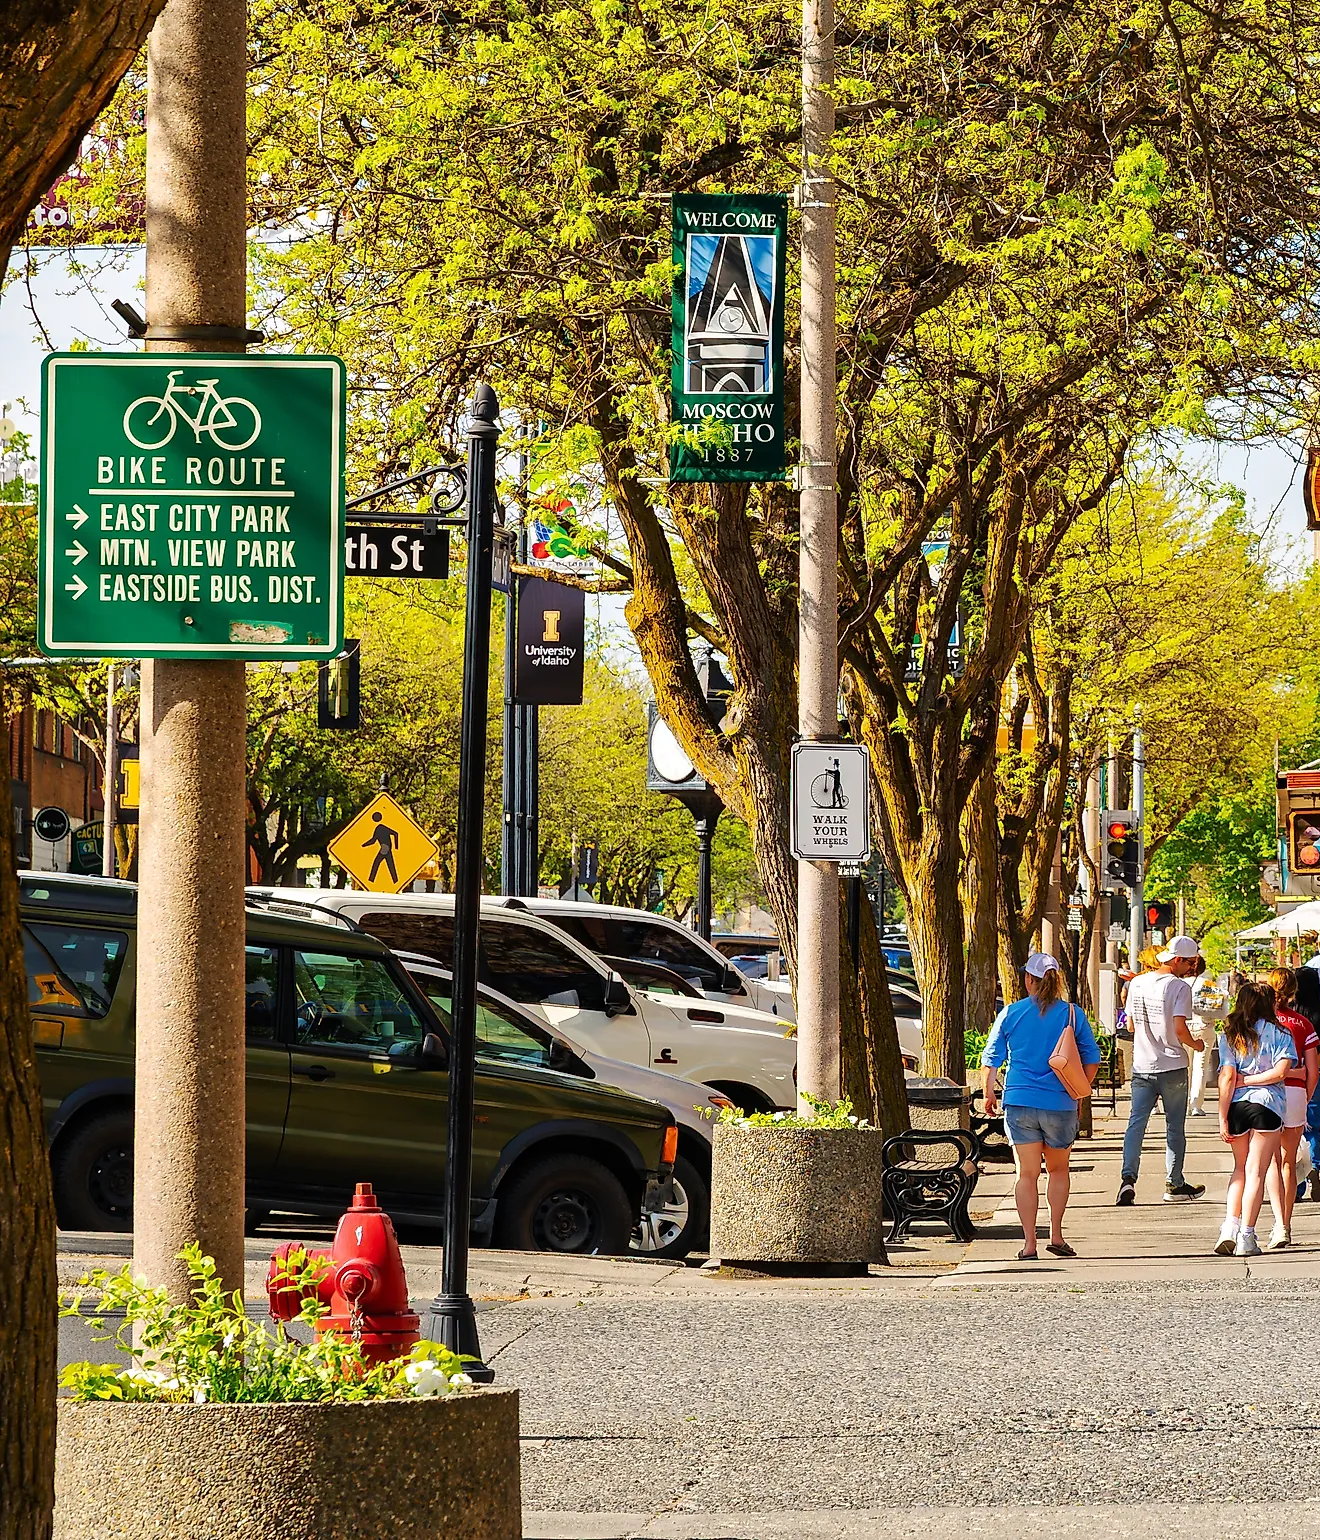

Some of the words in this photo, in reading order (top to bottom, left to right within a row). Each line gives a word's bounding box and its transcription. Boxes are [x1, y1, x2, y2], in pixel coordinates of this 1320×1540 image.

[684, 211, 777, 229] WELCOME
[682, 403, 775, 419] MOSCOW
[704, 448, 754, 463] 1887
[97, 456, 167, 484] BIKE
[186, 457, 286, 486] ROUTE
[100, 503, 160, 532] EAST
[168, 504, 221, 532] CITY
[231, 505, 291, 533] PARK
[100, 539, 157, 566] MTN.
[168, 539, 226, 567] VIEW
[236, 540, 296, 568] PARK
[390, 535, 425, 572] St
[100, 574, 201, 602] EASTSIDE
[210, 575, 259, 603] BUS.
[268, 576, 321, 604] DIST.
[525, 644, 577, 659] University
[532, 657, 542, 667] of
[541, 655, 570, 666] Idaho
[812, 815, 848, 825] WALK
[812, 826, 848, 836] YOUR
[813, 837, 849, 846] WHEELS
